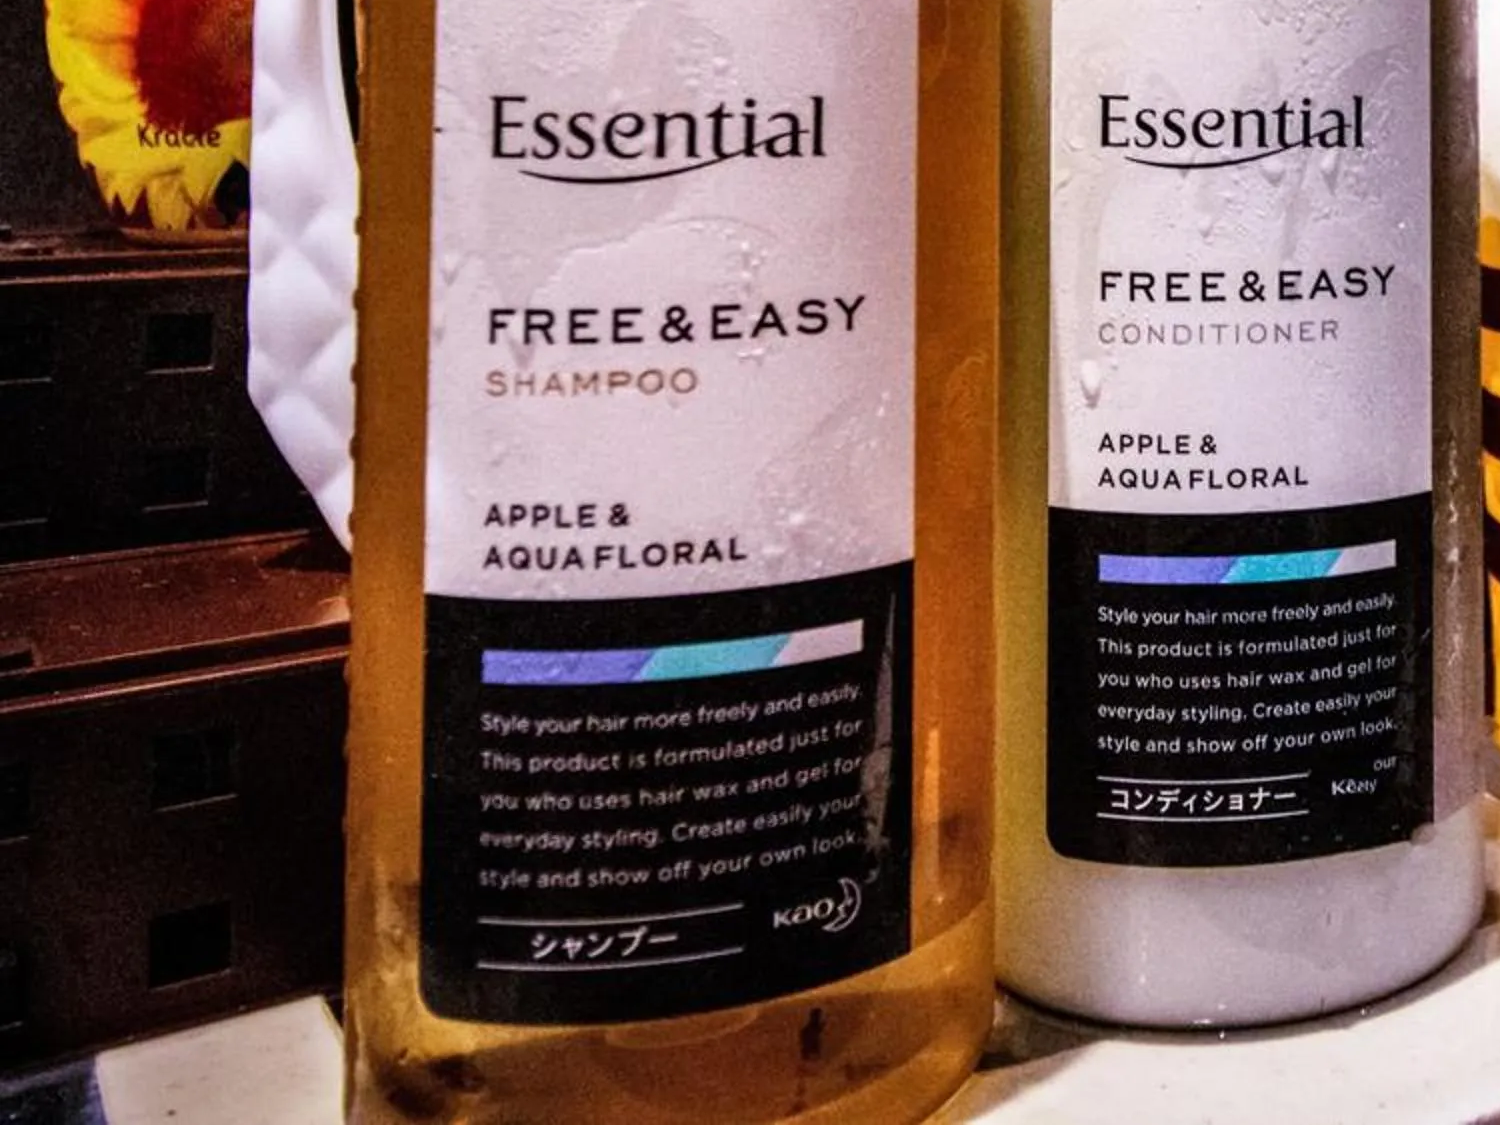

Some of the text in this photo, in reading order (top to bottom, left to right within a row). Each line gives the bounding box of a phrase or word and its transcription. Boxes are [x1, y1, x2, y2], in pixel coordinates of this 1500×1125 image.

[490, 94, 827, 162] Essential
[1099, 94, 1365, 152] Essential
[1098, 320, 1340, 347] CONDITIONER
[486, 368, 698, 398] SHAMPOO
[1098, 432, 1217, 455] APPLE &
[484, 503, 632, 529] APPLE &
[1097, 605, 1139, 627] Style
[1141, 609, 1181, 627] your
[1184, 608, 1218, 625] hair
[1222, 608, 1267, 624] more
[1271, 603, 1319, 622] freely
[1322, 600, 1353, 618] and
[1097, 623, 1397, 660] This product is formulated just for
[1098, 654, 1397, 690] you who uses hair wax and gel for
[480, 712, 529, 736] Style
[534, 718, 583, 737] your
[586, 714, 629, 733] hair
[634, 713, 691, 730] more
[698, 700, 759, 723] freely
[764, 693, 802, 716] and
[1097, 685, 1397, 725] everyday styling. Create easily your
[480, 718, 864, 774] This product is formulated just for
[1097, 716, 1398, 754] style and show off your own look.
[1373, 755, 1397, 772] our
[480, 755, 862, 812] you who uses hair wax and gel for
[1111, 786, 1297, 813] コンディショナー
[479, 830, 575, 854] everyday
[671, 817, 747, 843] Create
[753, 803, 814, 831] easily
[819, 794, 862, 819] your
[479, 830, 863, 891] style and show off your own look.
[530, 928, 680, 961] シャンプー
